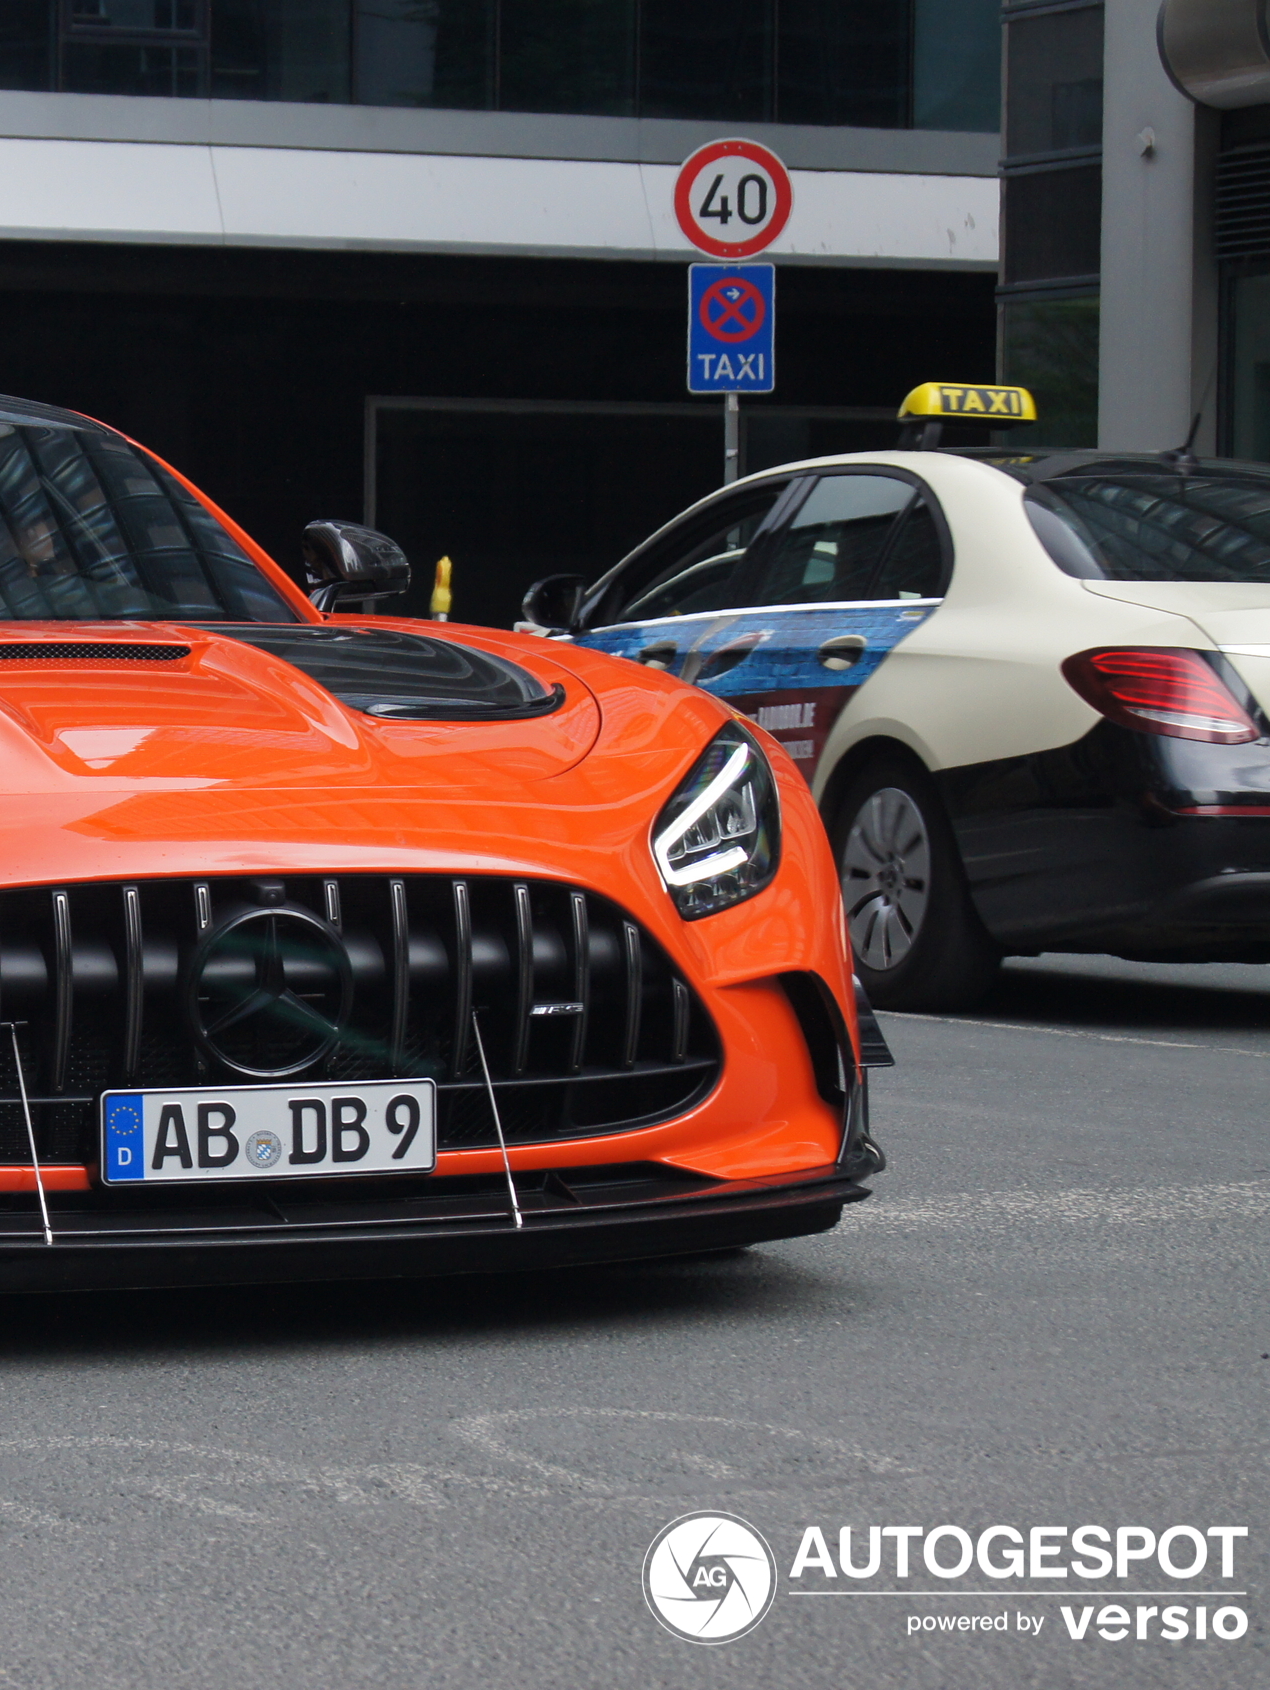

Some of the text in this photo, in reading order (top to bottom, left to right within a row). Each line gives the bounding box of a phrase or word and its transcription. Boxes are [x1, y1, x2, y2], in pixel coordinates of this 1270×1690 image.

[699, 173, 768, 225] 40
[697, 354, 764, 381] TAXI
[941, 388, 1021, 414] TAXI
[151, 1101, 240, 1170] AB
[288, 1095, 371, 1165] DB
[385, 1093, 421, 1160] 9
[117, 1146, 132, 1166] D
